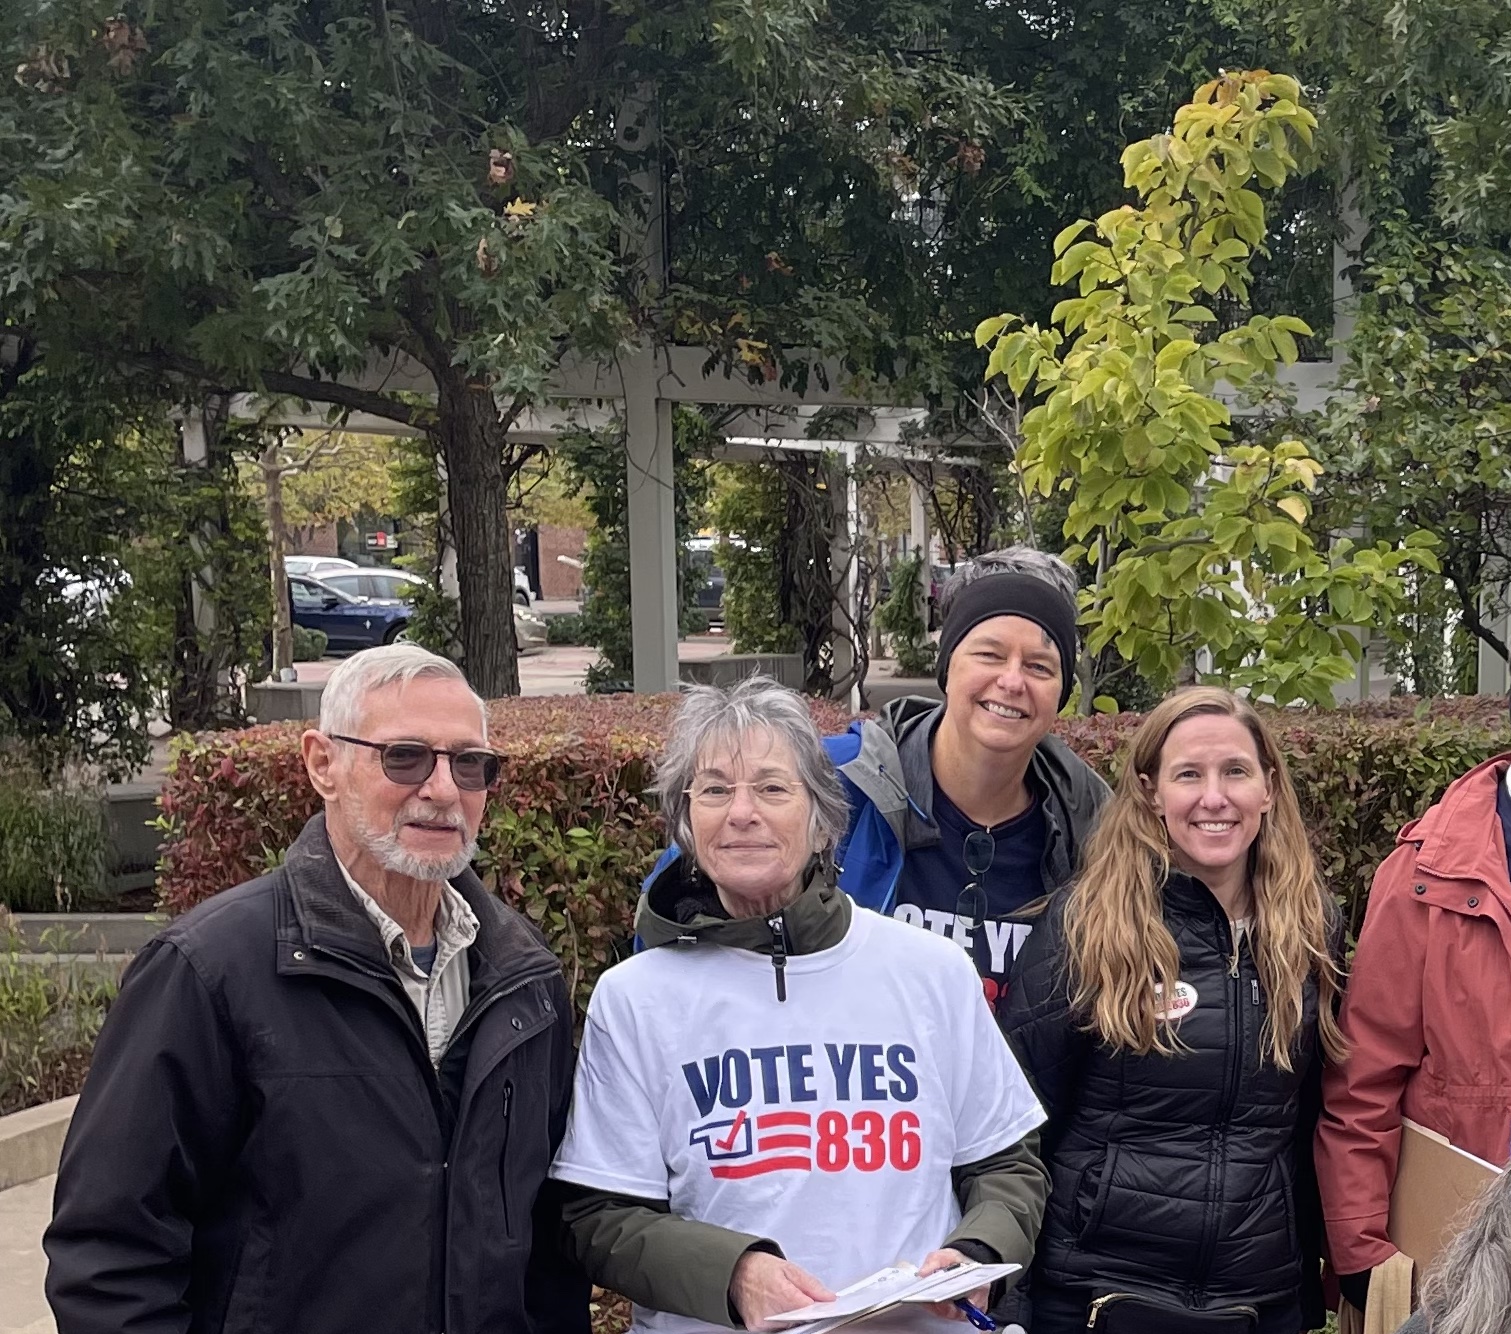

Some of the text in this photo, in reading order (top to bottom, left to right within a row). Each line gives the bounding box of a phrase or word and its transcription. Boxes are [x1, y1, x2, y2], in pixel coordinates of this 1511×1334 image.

[681, 1043, 919, 1118] VOTE YES
[816, 1110, 921, 1173] 836
